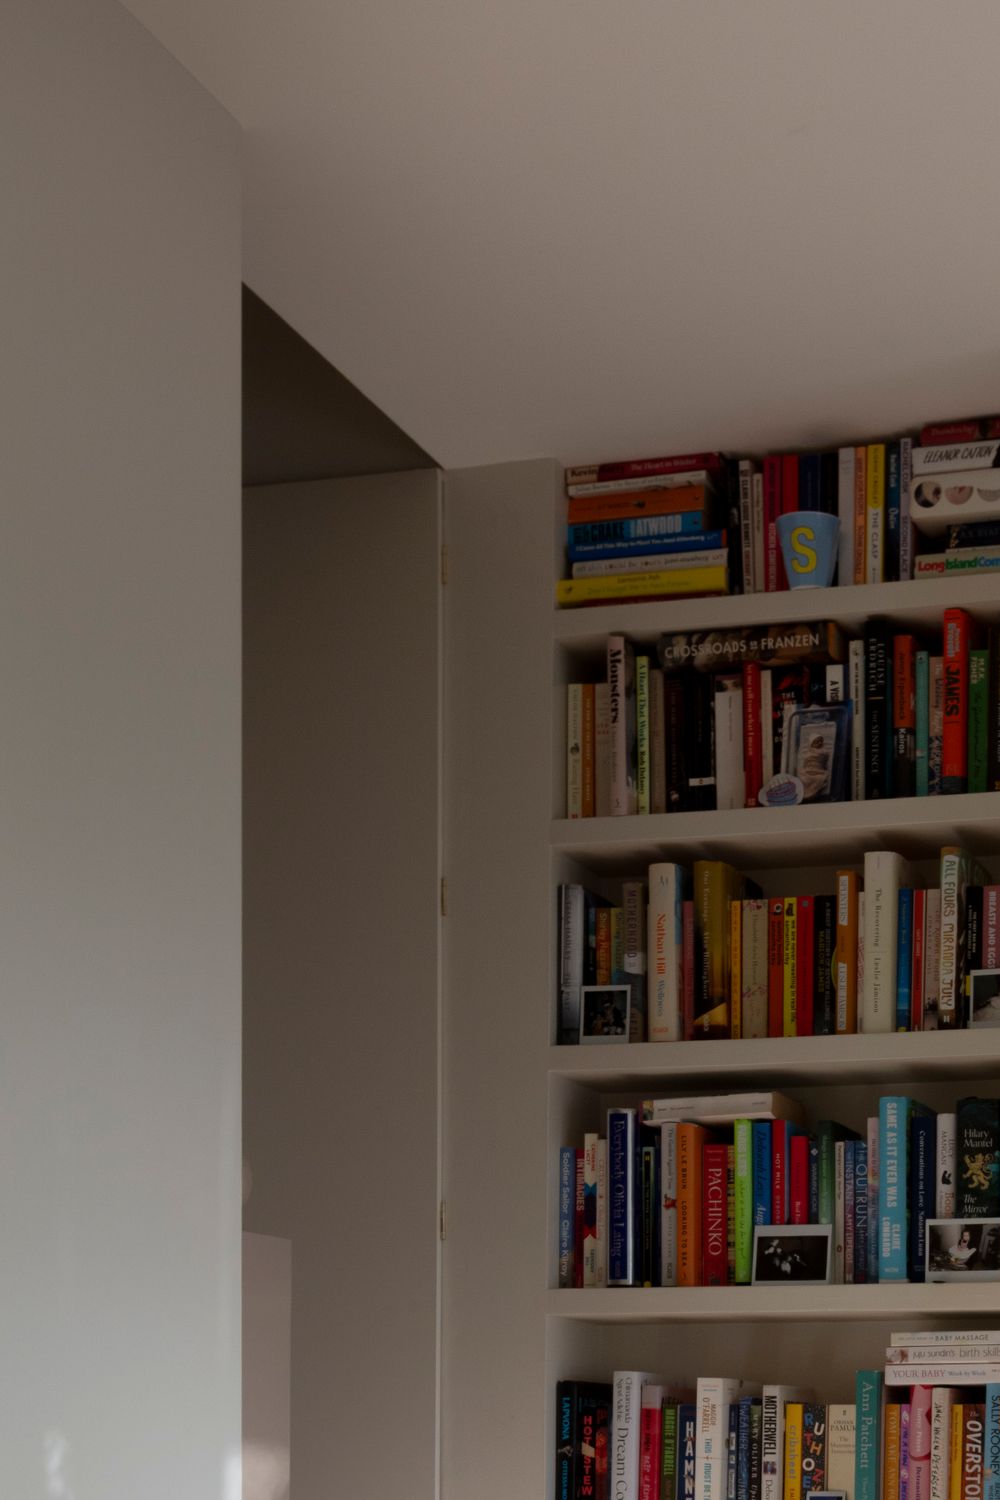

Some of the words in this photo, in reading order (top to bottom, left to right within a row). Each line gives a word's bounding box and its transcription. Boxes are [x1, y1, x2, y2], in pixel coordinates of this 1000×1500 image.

[923, 449, 959, 464] ELEANOR
[961, 444, 994, 460] CATTON
[571, 468, 598, 478] Kevin
[791, 525, 817, 574] S
[918, 560, 944, 572] Long
[946, 557, 977, 570] Island
[664, 640, 747, 659] CROSSROADS
[761, 633, 820, 650] FRANZEN
[868, 639, 877, 691] ERDRICH
[877, 643, 885, 686] LOUISE
[609, 649, 623, 724] Monsters
[639, 671, 647, 695] Heart
[946, 666, 960, 717] JAMES
[639, 699, 647, 717] That
[639, 720, 647, 747] Works
[898, 729, 907, 754] Kairos
[638, 751, 646, 764] Rob
[944, 861, 956, 879] ALL
[875, 889, 883, 902] The
[944, 882, 957, 917] FOURS
[988, 891, 998, 925] BREASTS
[627, 891, 638, 958] MOTHERHOOD
[656, 914, 667, 953] Nathan
[873, 905, 882, 947] Recovering
[988, 928, 997, 944] AND
[943, 923, 956, 975] MIRANDA
[987, 947, 997, 969] EGGS
[656, 957, 666, 974] Hill
[873, 958, 882, 980] Leslie
[656, 980, 664, 1016] Wellness
[873, 984, 882, 1013] Jamison
[942, 979, 956, 1006] JULY
[886, 1103, 897, 1129] SAME
[886, 1132, 897, 1144] AS
[964, 1128, 989, 1138] Hilary
[964, 1139, 993, 1148] Mantel
[611, 1121, 626, 1180] Everybody
[681, 1155, 688, 1164] LE
[887, 1147, 897, 1156] IT
[561, 1152, 570, 1184] Soldier
[886, 1160, 897, 1184] EVER
[576, 1159, 585, 1210] INTIMACIES
[856, 1163, 867, 1227] OUTRUN
[886, 1187, 897, 1207] WAS
[561, 1188, 570, 1213] Sailor
[612, 1184, 626, 1219] Olivia
[707, 1168, 723, 1255] PACHINKO
[963, 1195, 978, 1204] The
[963, 1206, 989, 1215] Mirror
[561, 1220, 570, 1246] Claire
[611, 1223, 625, 1257] Laing
[681, 1239, 688, 1247] TO
[882, 1217, 891, 1257] LOMBARDO
[893, 1224, 901, 1249] CLAIRE
[560, 1250, 570, 1276] Kilroy
[954, 1334, 988, 1342] MASSAGE
[913, 1348, 926, 1359] juju
[928, 1347, 955, 1358] sundin's
[960, 1345, 980, 1357] birth
[893, 1369, 919, 1378] YOUR
[921, 1369, 945, 1378] BABY
[862, 1382, 874, 1411] Ann
[990, 1395, 1000, 1423] SALLY
[562, 1397, 570, 1440] LAPVONA
[583, 1415, 593, 1447] HOT
[764, 1396, 778, 1456] MOTHERWELL
[616, 1427, 630, 1475] Dream
[788, 1425, 800, 1478] cribsheet
[860, 1416, 874, 1467] Patchett
[989, 1429, 1000, 1475] ROONEY
[583, 1455, 593, 1495] STEW
